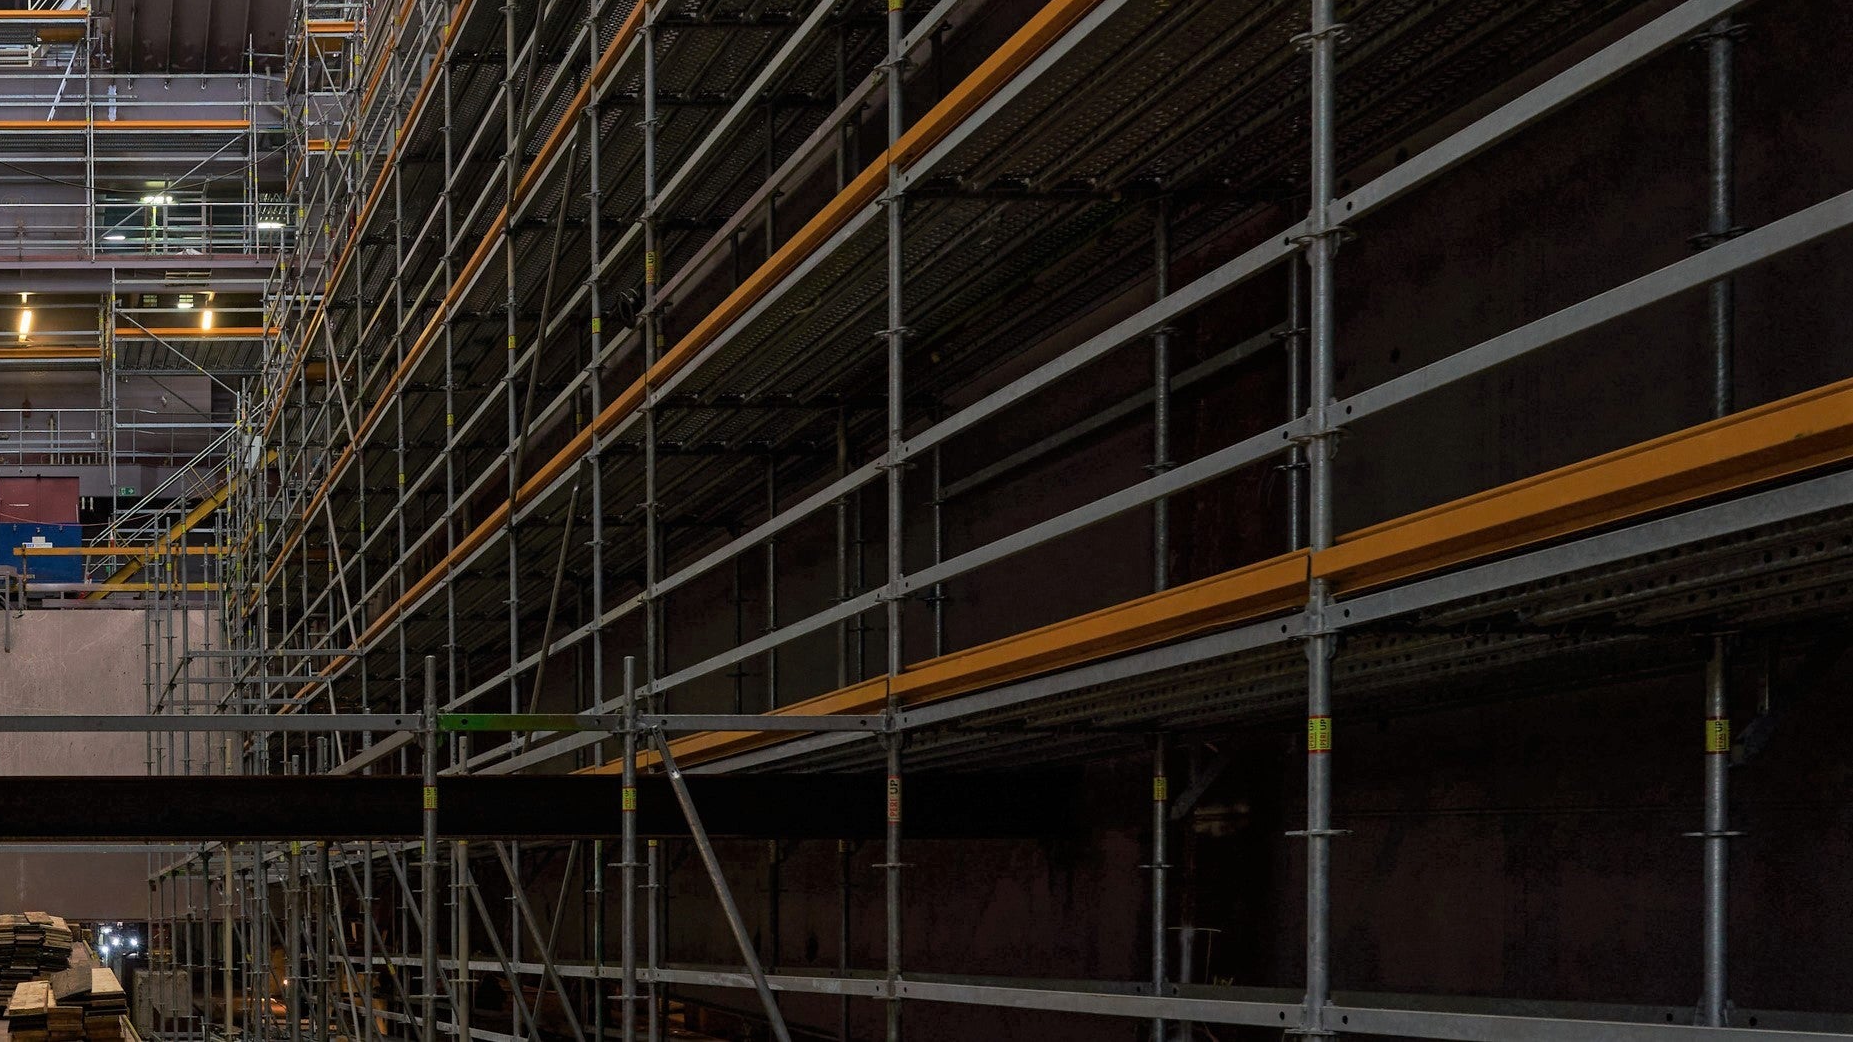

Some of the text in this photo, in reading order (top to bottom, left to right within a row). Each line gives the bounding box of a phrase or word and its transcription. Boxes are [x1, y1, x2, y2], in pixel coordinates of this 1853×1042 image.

[1320, 719, 1327, 731] UP
[1716, 721, 1723, 732] UP
[889, 779, 899, 817] PERI UP
